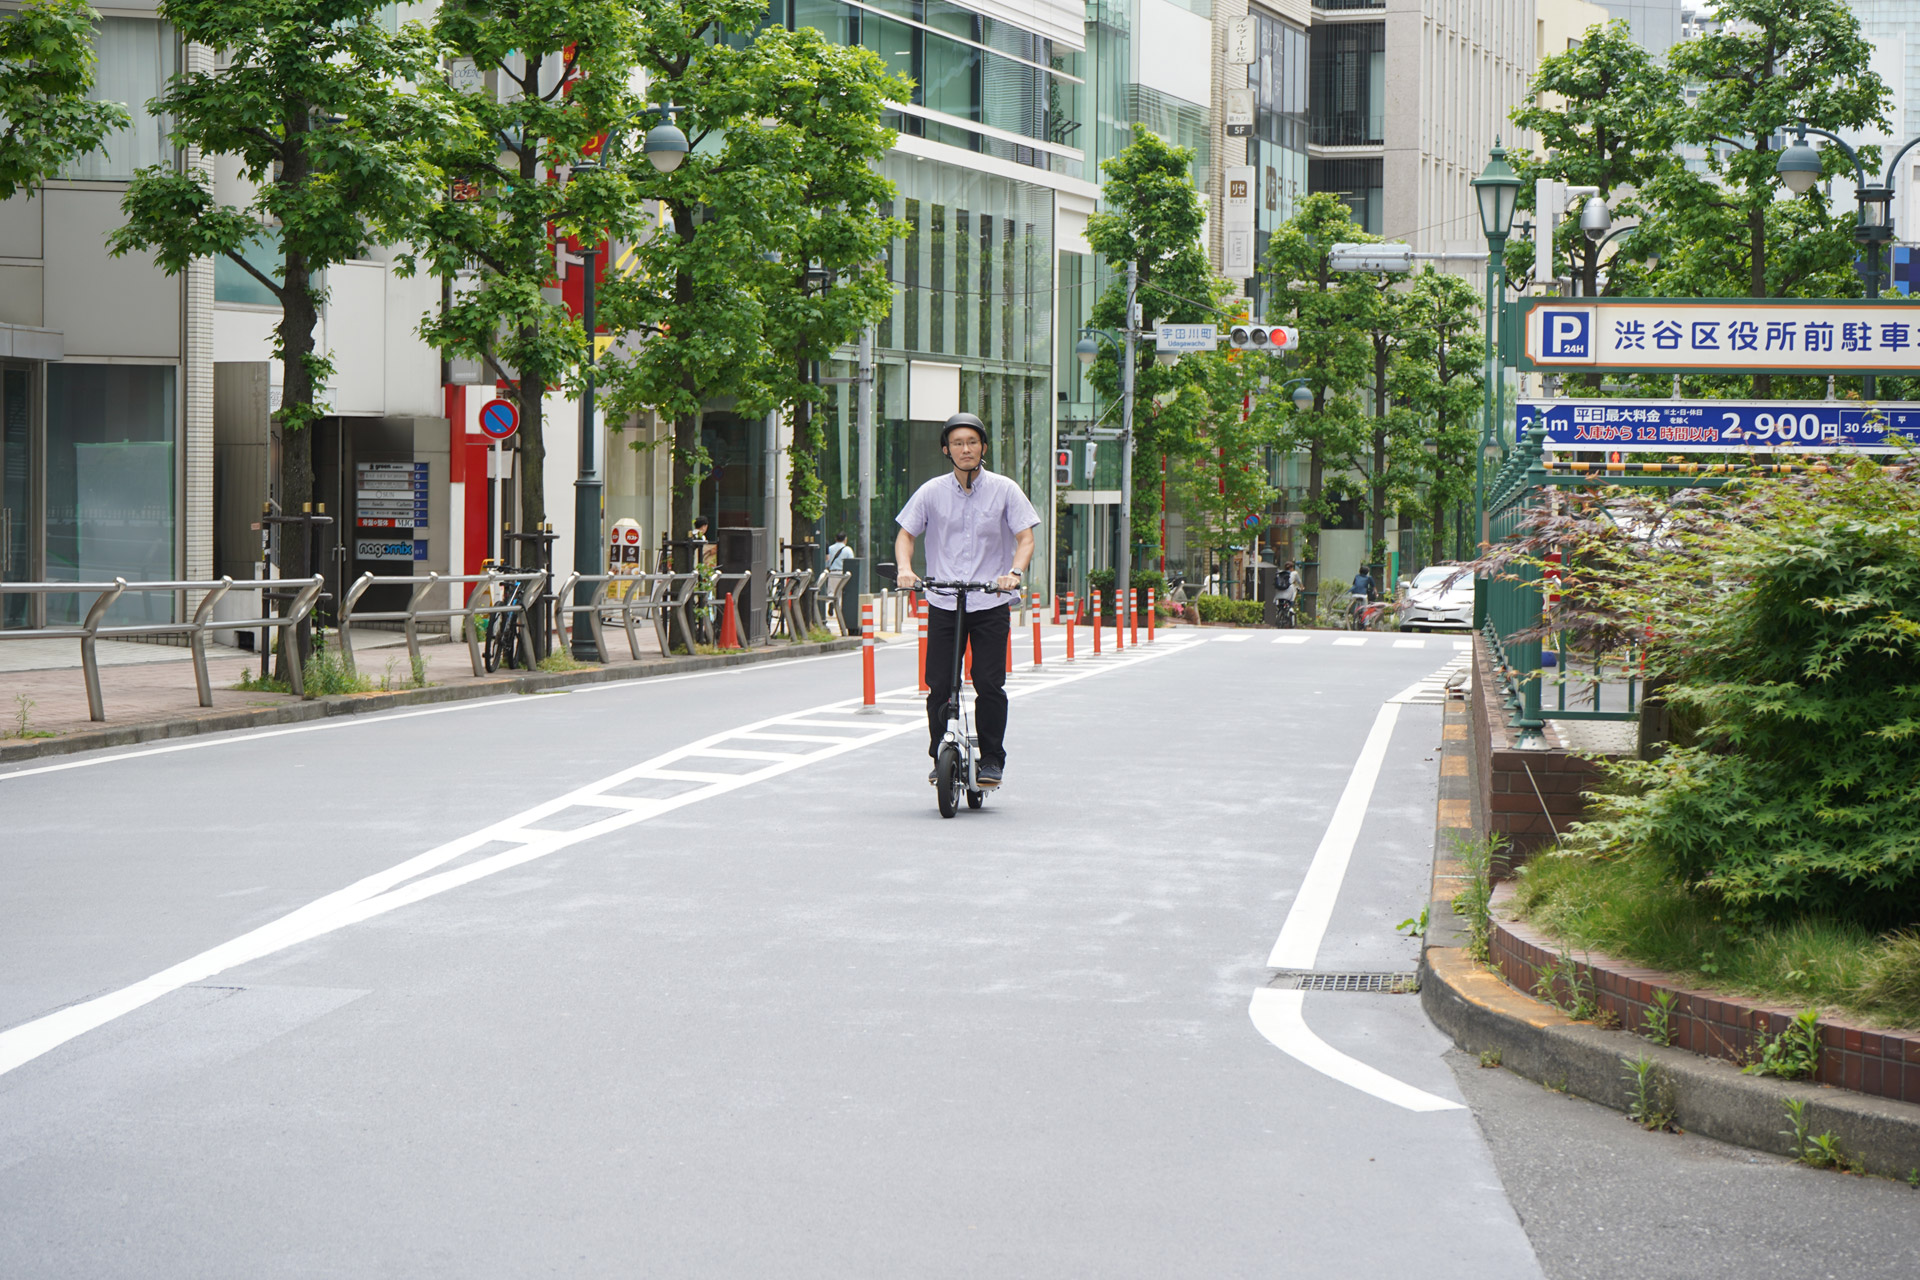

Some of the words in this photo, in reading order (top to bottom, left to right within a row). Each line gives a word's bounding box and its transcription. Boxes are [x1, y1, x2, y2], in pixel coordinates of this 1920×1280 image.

[1234, 126, 1245, 135] 5F
[1162, 328, 1212, 339] 宇田川町
[1553, 315, 1582, 353] P
[1614, 319, 1920, 353] 渋谷区役所前駐車
[1168, 340, 1206, 348] Udagawacho
[1563, 344, 1584, 354] 24H
[359, 541, 413, 558] nagomix
